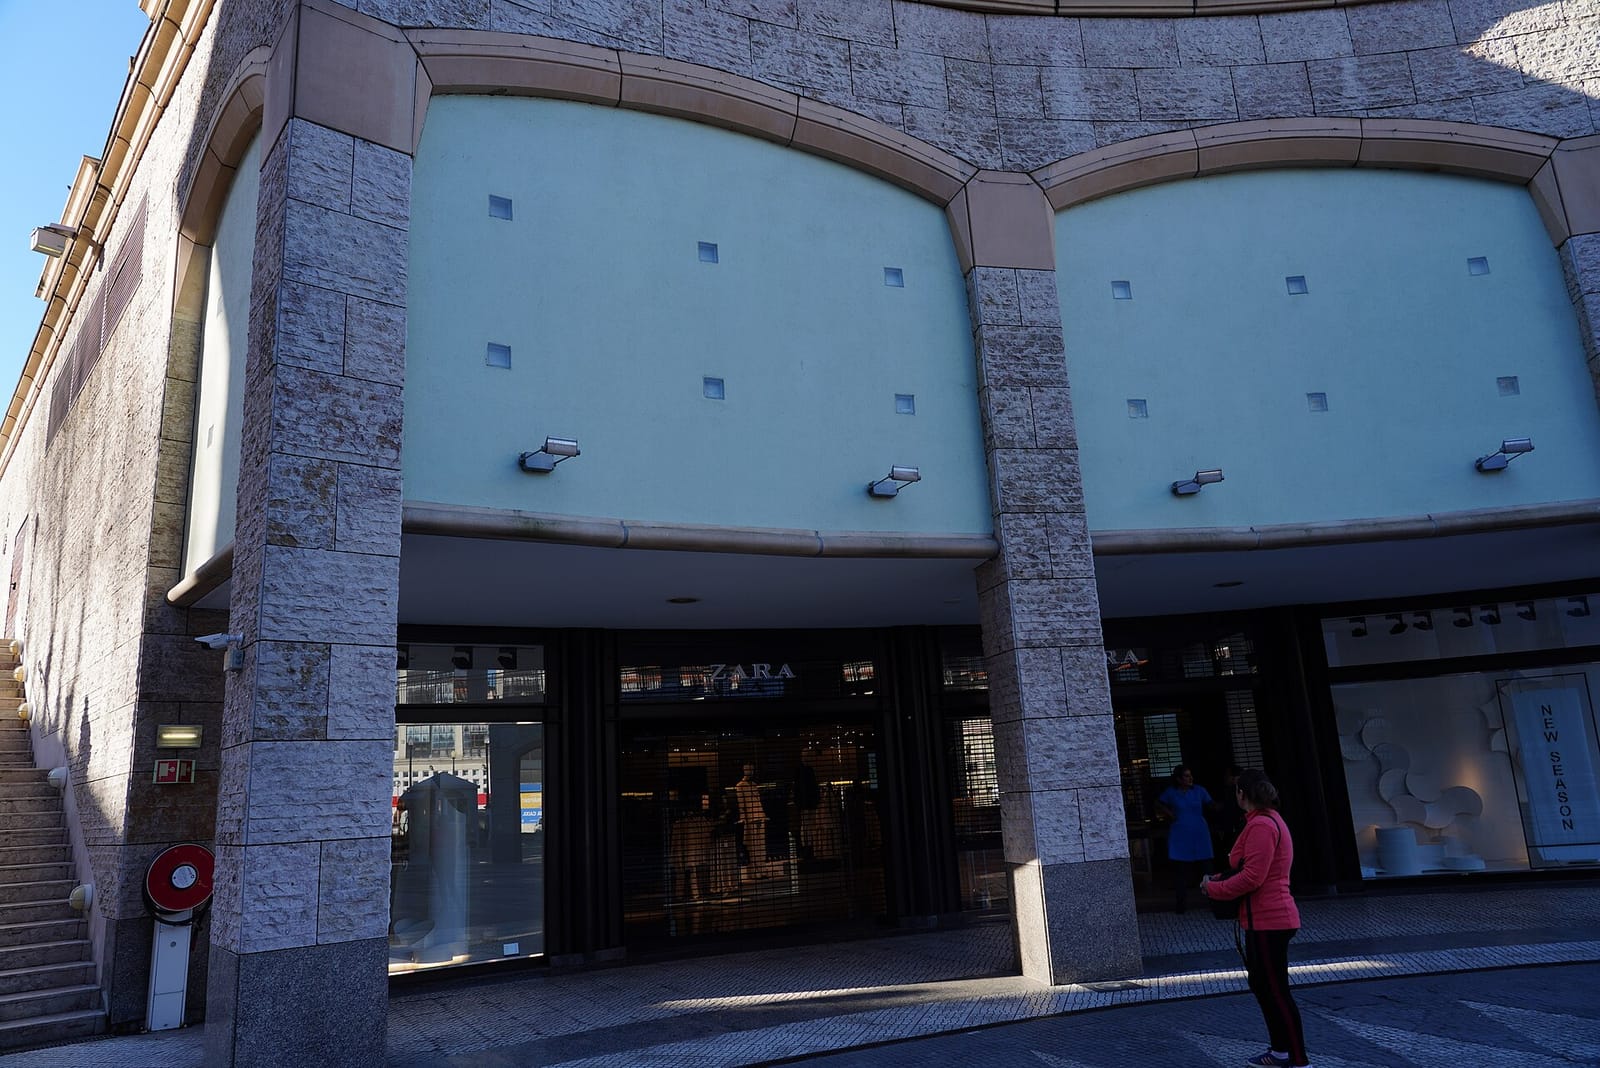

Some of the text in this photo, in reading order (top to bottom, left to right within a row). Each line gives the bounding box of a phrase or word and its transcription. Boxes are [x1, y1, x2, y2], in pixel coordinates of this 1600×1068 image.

[1104, 649, 1138, 665] RA
[709, 663, 797, 680] ZARA
[1541, 705, 1574, 831] NEW SEASON
